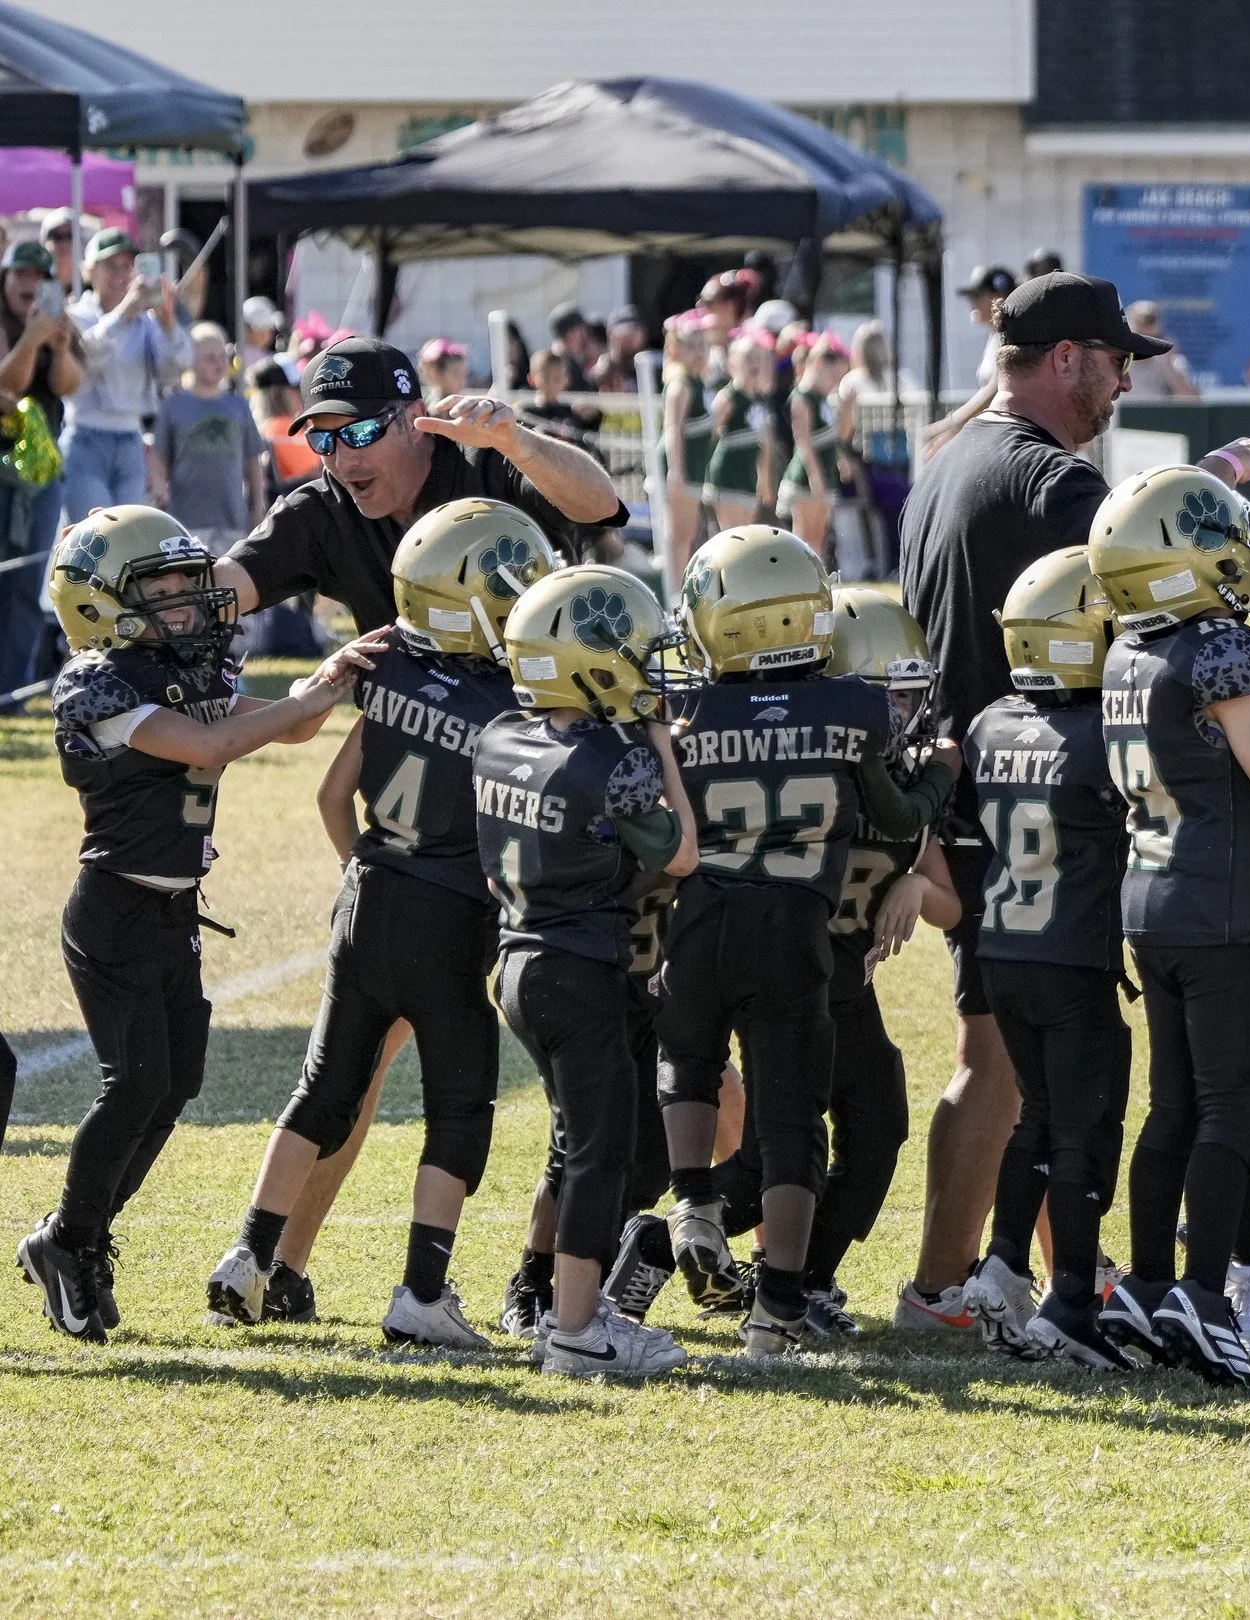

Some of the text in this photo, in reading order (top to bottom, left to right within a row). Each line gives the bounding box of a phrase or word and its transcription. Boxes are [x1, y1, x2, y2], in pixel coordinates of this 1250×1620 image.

[310, 380, 353, 395] FOOTBALL
[427, 668, 461, 687] Riddell
[750, 694, 789, 702] Riddell
[679, 725, 868, 768] BROWNLEE
[975, 750, 1068, 786] LENTZ
[373, 751, 430, 857] 4
[476, 775, 567, 834] MYERS
[978, 798, 1063, 935] 18
